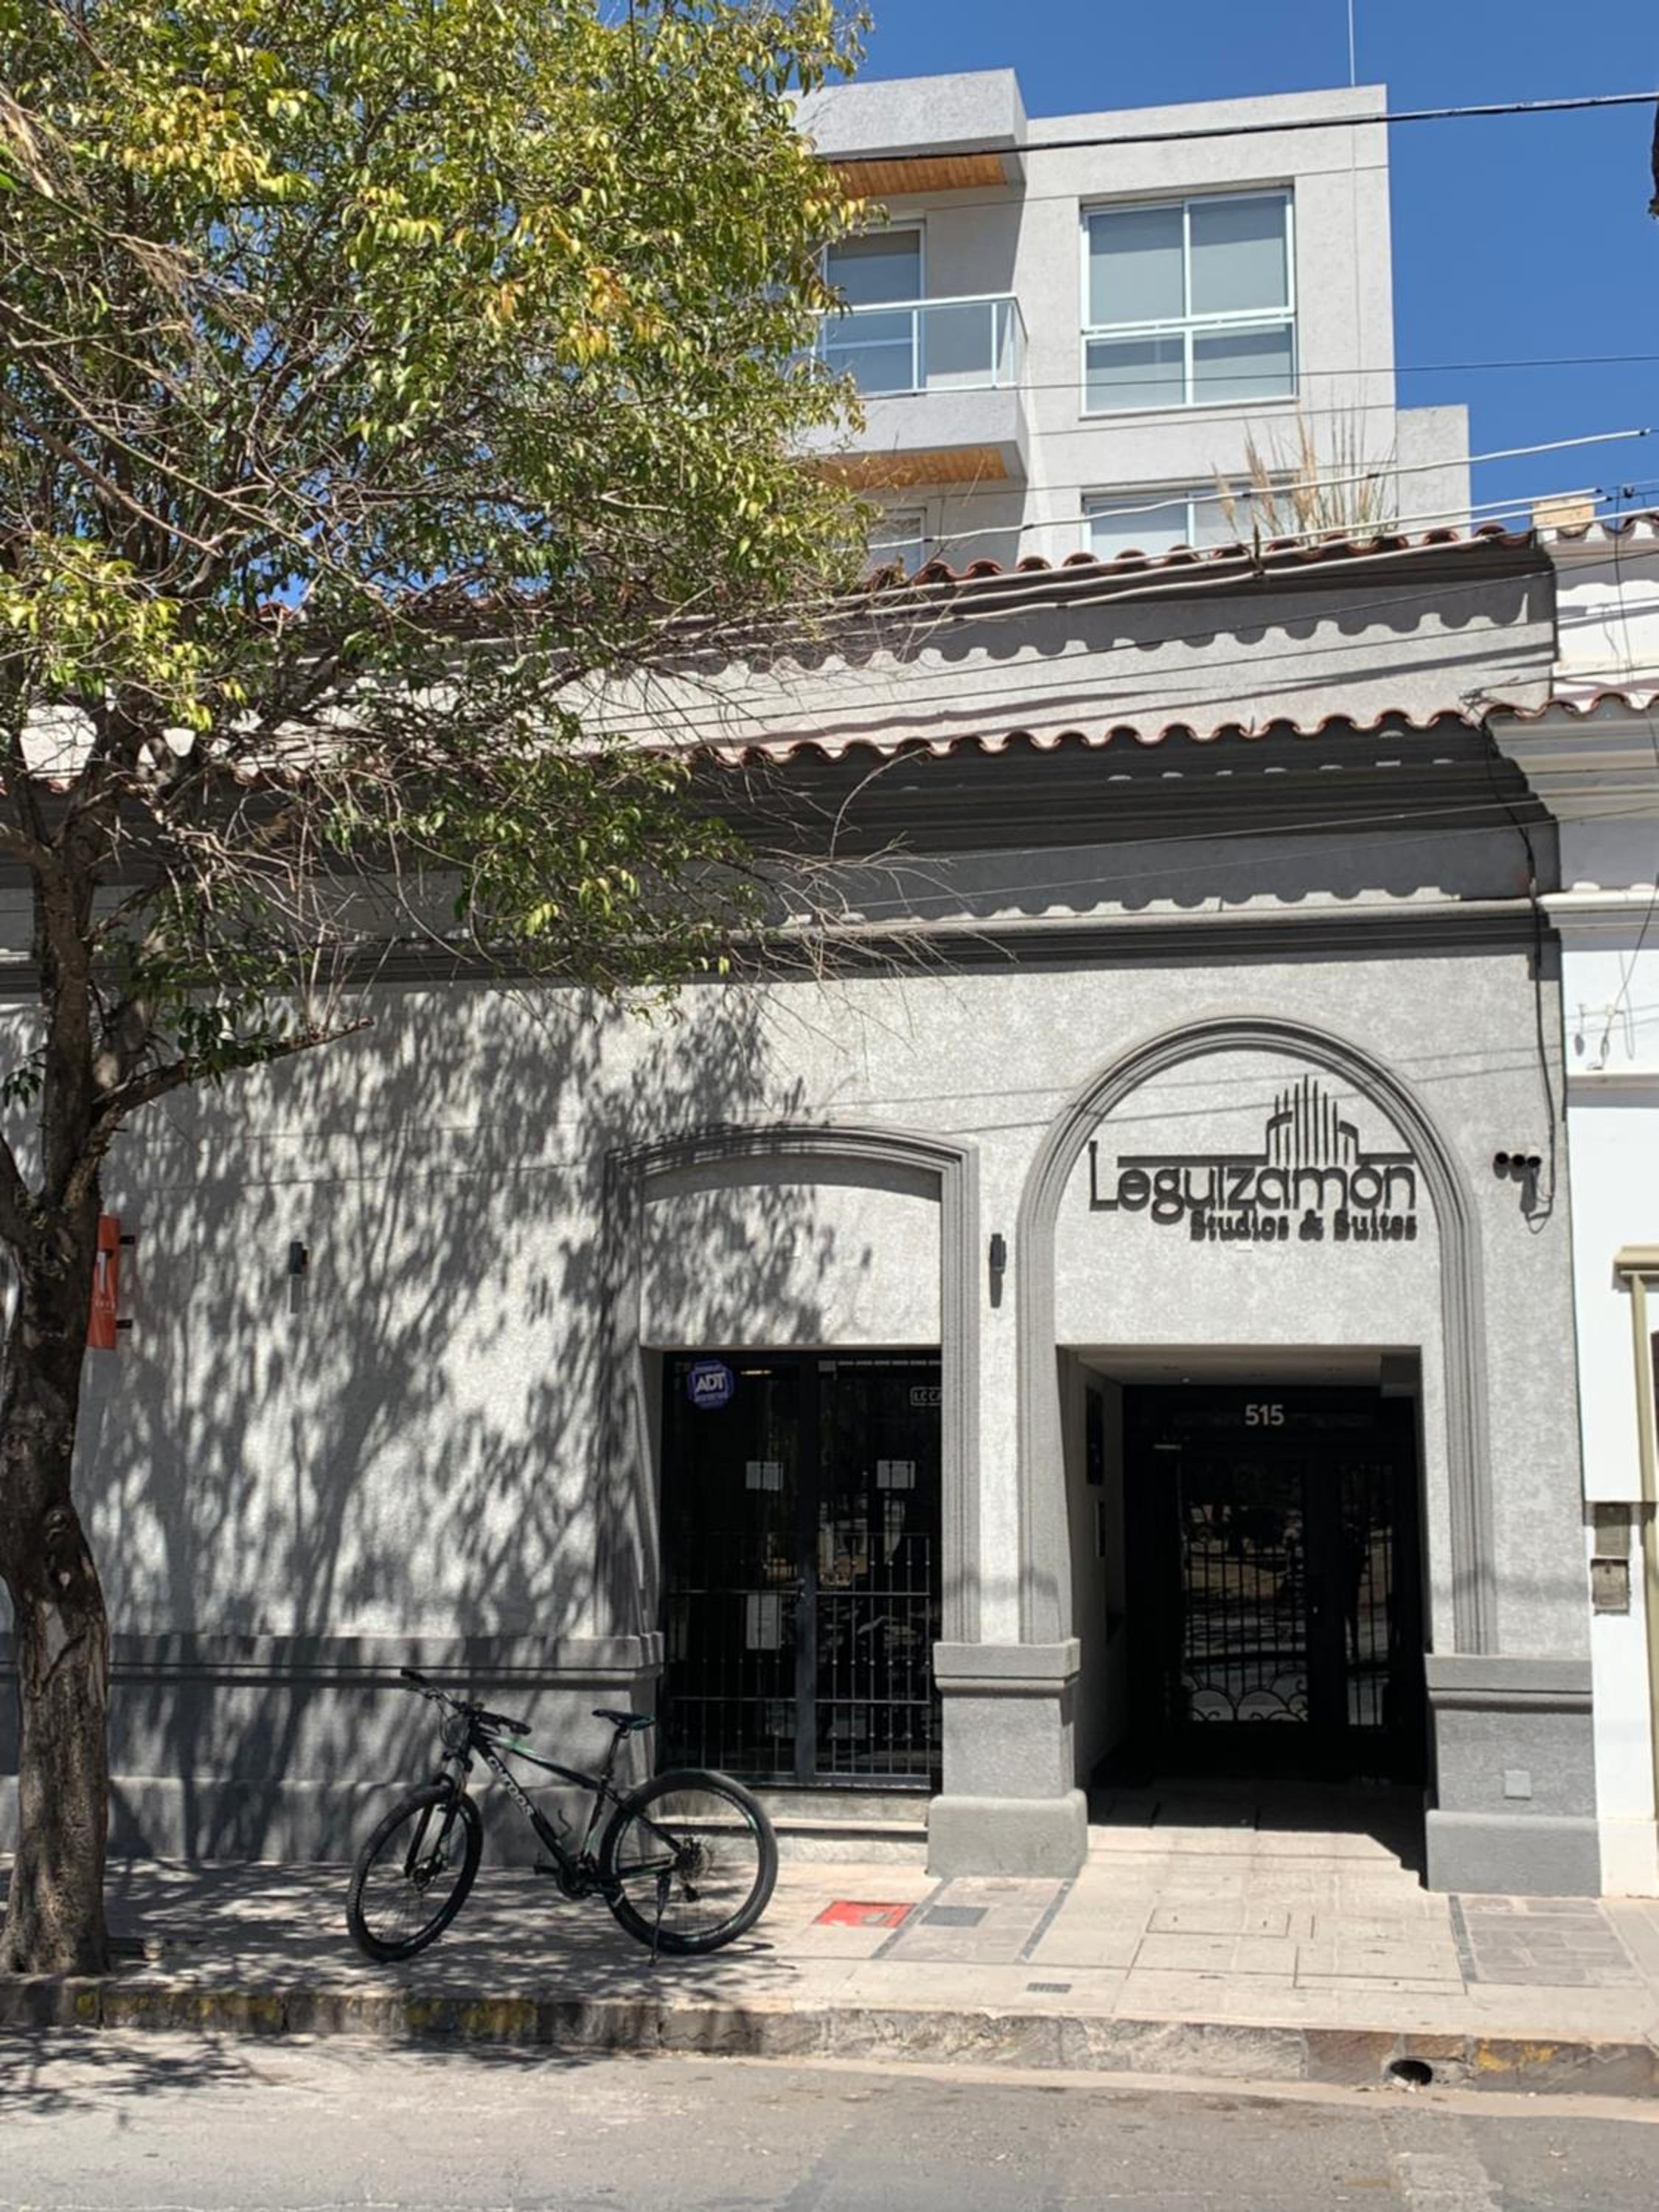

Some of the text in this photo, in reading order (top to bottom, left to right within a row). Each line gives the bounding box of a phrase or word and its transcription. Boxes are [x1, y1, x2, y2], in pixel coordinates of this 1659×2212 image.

[1190, 1208, 1417, 1241] Studios & Suites
[695, 1372, 726, 1393] ADT
[1245, 1404, 1284, 1426] 515
